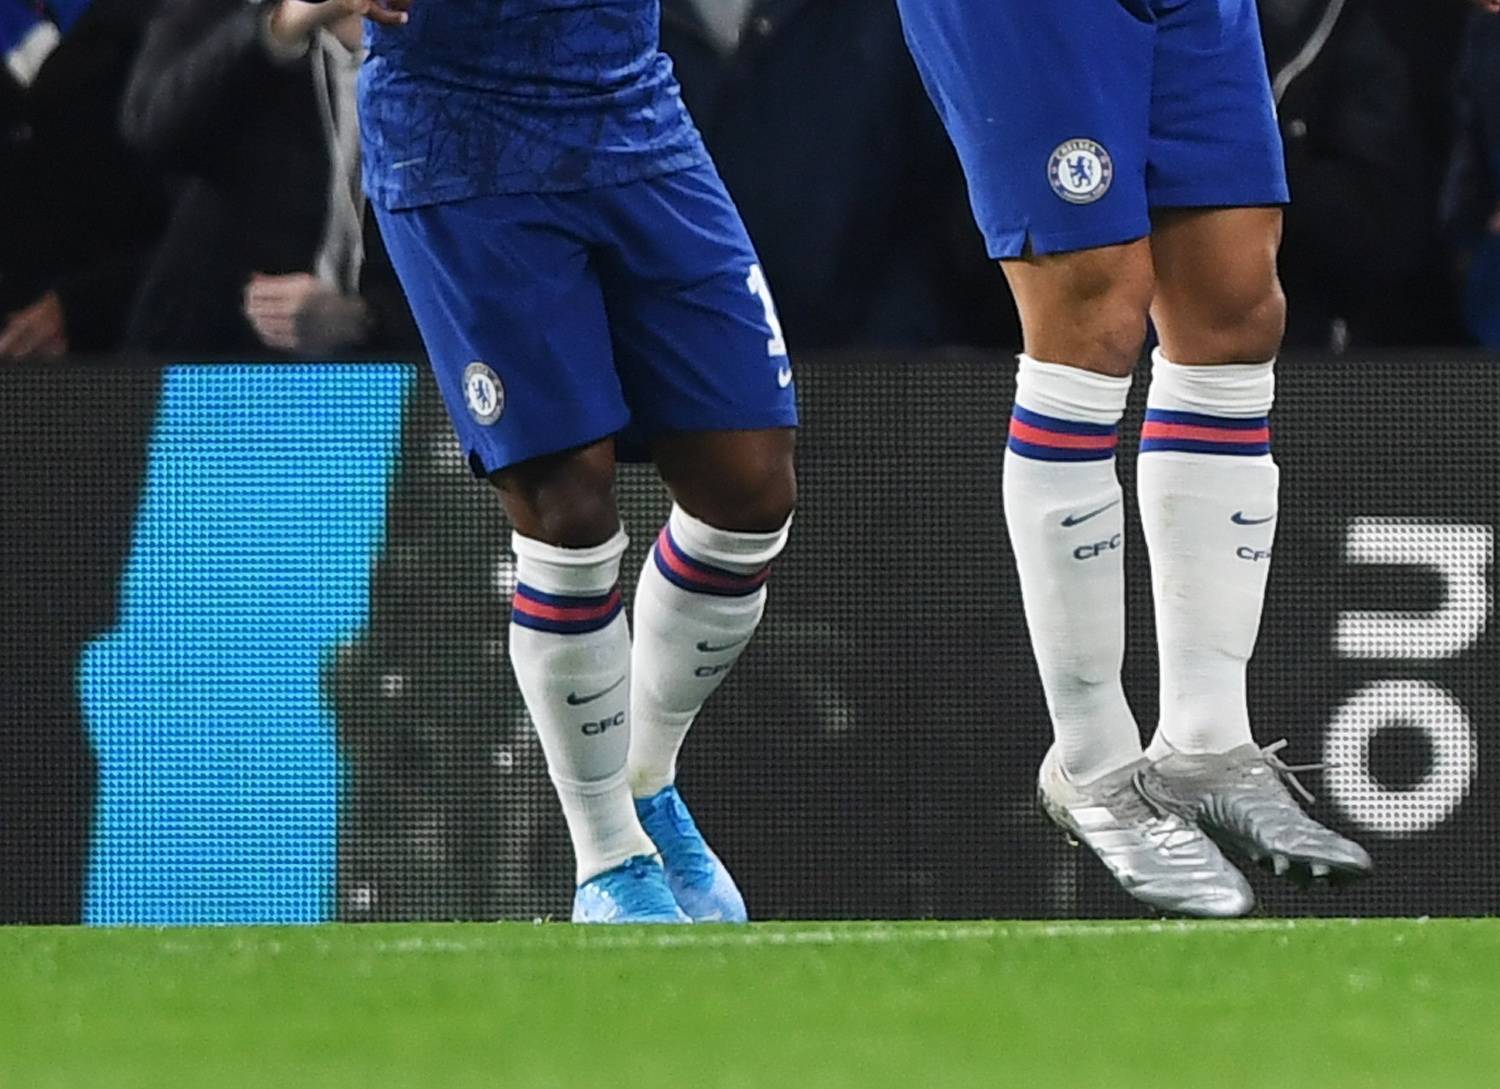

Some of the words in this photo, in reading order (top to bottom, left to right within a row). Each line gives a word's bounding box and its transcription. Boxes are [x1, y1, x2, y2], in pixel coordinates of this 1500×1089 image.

[1073, 533, 1121, 560] CFC
[1236, 546, 1271, 562] CF
[581, 711, 625, 736] CFC
